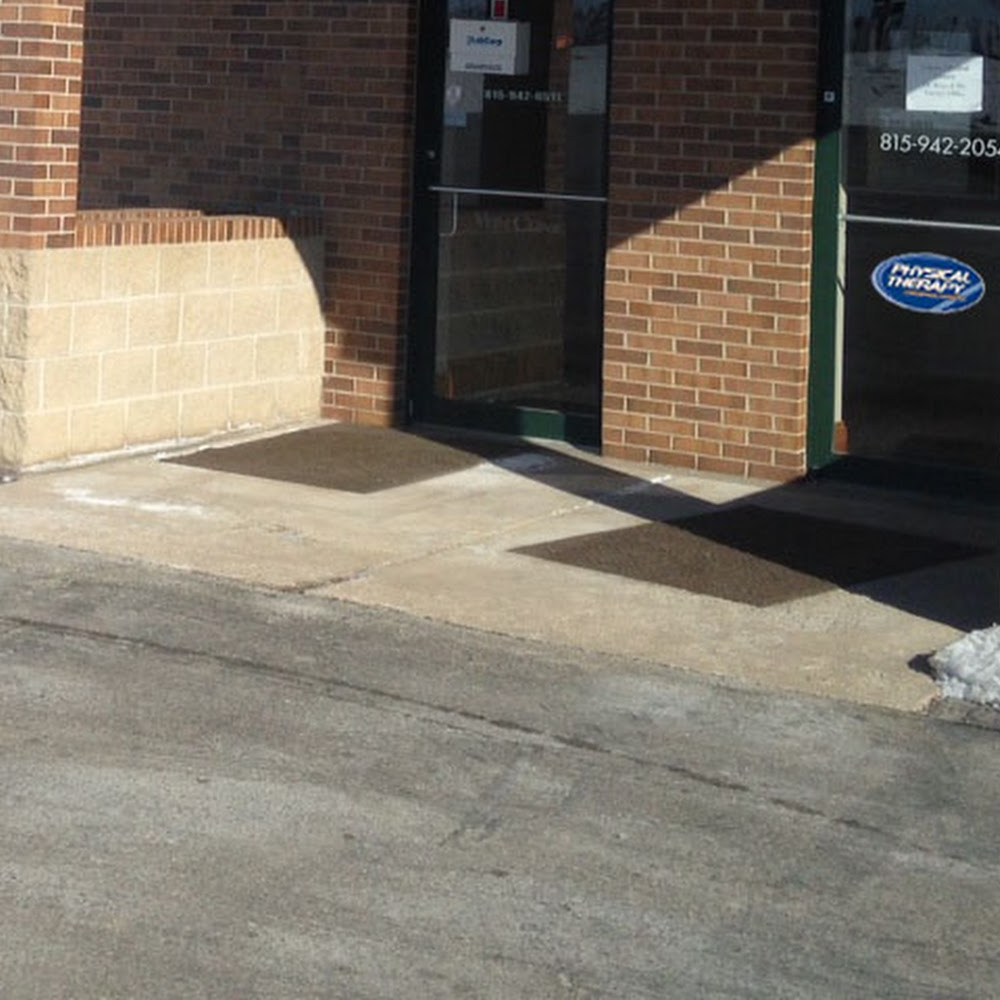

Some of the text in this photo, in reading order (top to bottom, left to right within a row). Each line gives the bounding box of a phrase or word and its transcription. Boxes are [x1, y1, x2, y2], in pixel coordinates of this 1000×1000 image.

[880, 132, 1000, 158] 815-942-205
[891, 263, 972, 284] PHYSICAL
[887, 275, 966, 295] THERAPY
